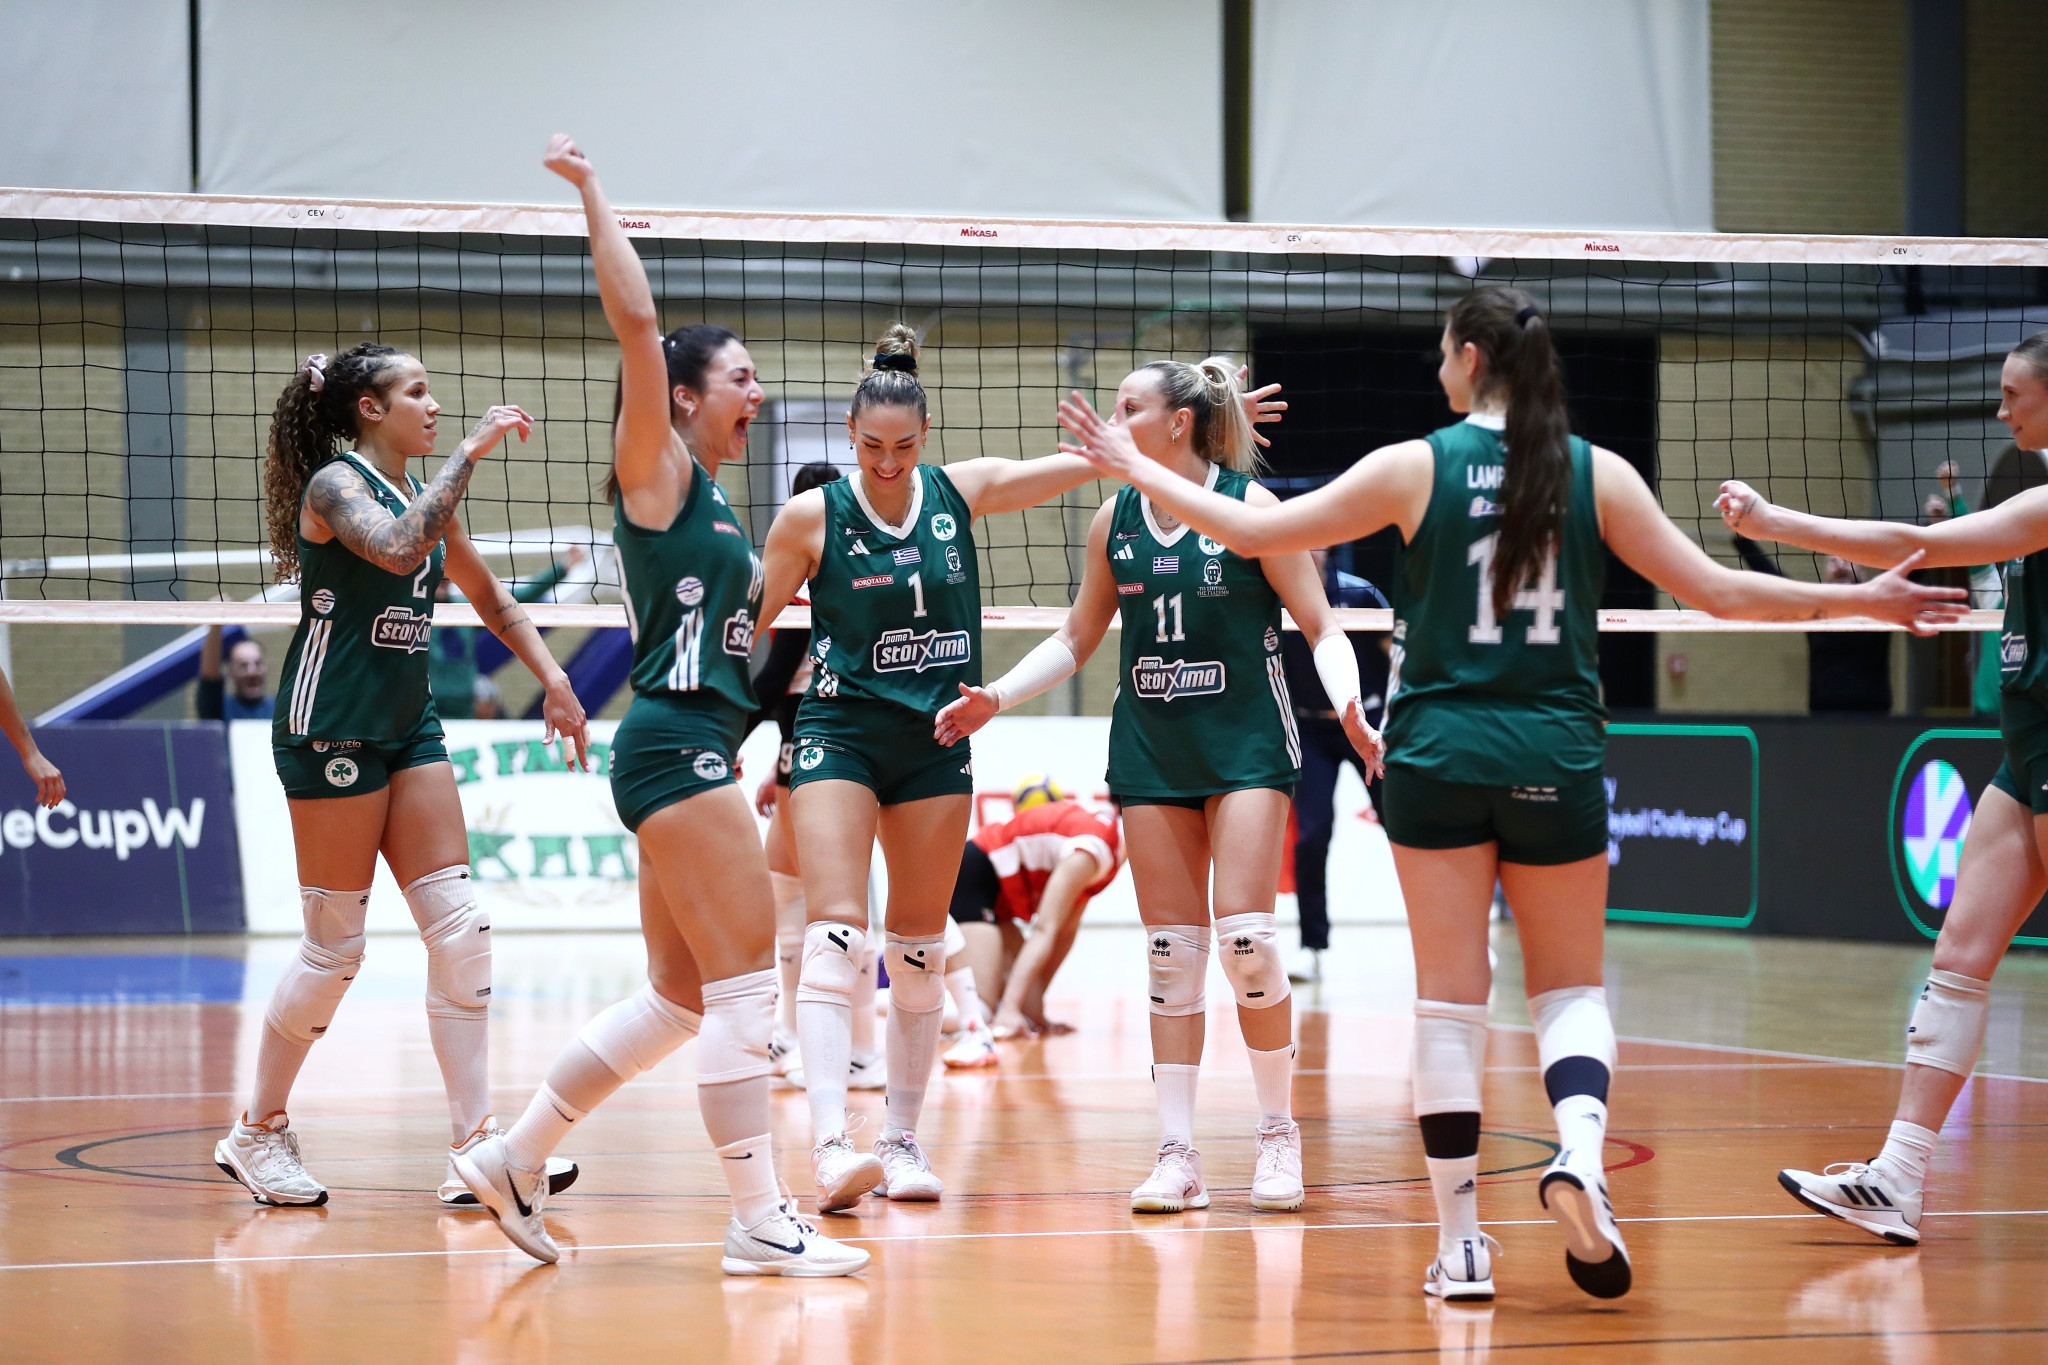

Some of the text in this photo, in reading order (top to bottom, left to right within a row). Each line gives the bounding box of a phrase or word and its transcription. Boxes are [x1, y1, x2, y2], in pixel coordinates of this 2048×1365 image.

[307, 209, 325, 217] CEV
[1893, 247, 1908, 255] CEV
[1466, 464, 1507, 489] LAMP
[412, 554, 431, 599] 2
[853, 576, 892, 588] BOROTALCO
[1466, 529, 1566, 645] 14
[907, 570, 928, 618] 1
[388, 611, 409, 620] pame
[1152, 592, 1186, 643] 11
[885, 633, 908, 645] pame
[1142, 661, 1159, 670] pame
[0, 797, 206, 861] eCupW
[1716, 810, 1747, 846] Cup
